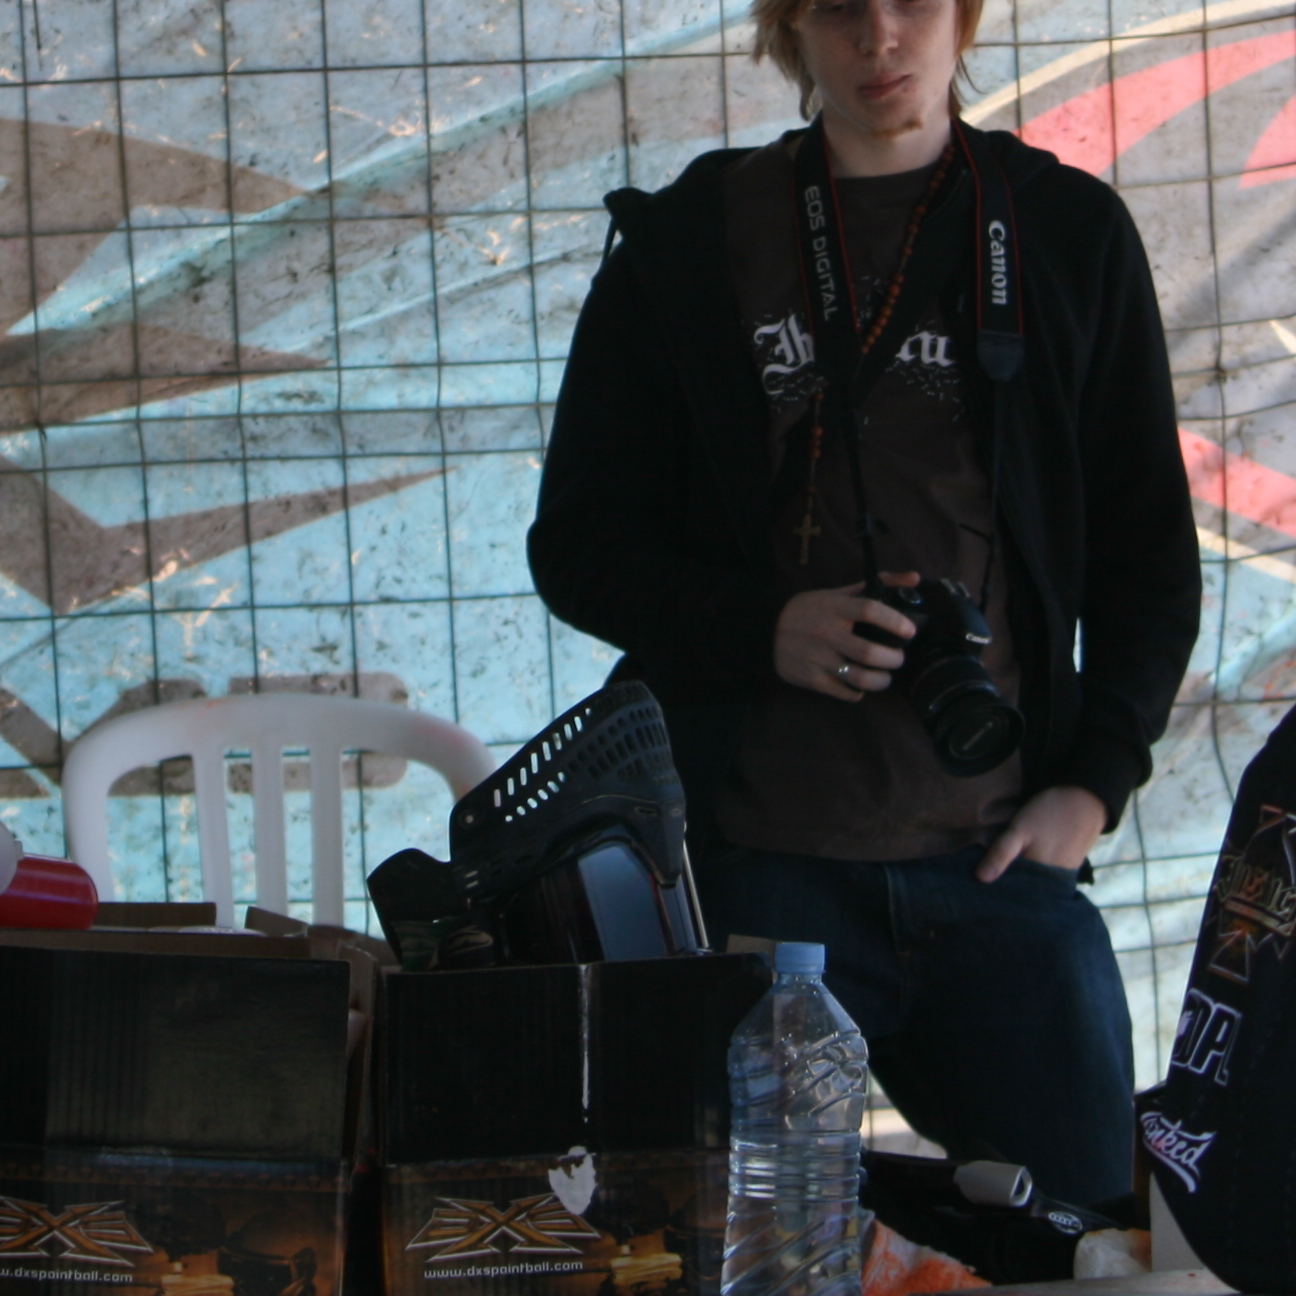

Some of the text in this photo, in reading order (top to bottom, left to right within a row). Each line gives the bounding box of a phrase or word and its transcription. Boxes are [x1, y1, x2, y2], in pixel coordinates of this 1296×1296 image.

[804, 185, 826, 232] EOS
[812, 236, 838, 321] DIGITAL
[423, 1259, 584, 1280] www.dxspaintball.com
